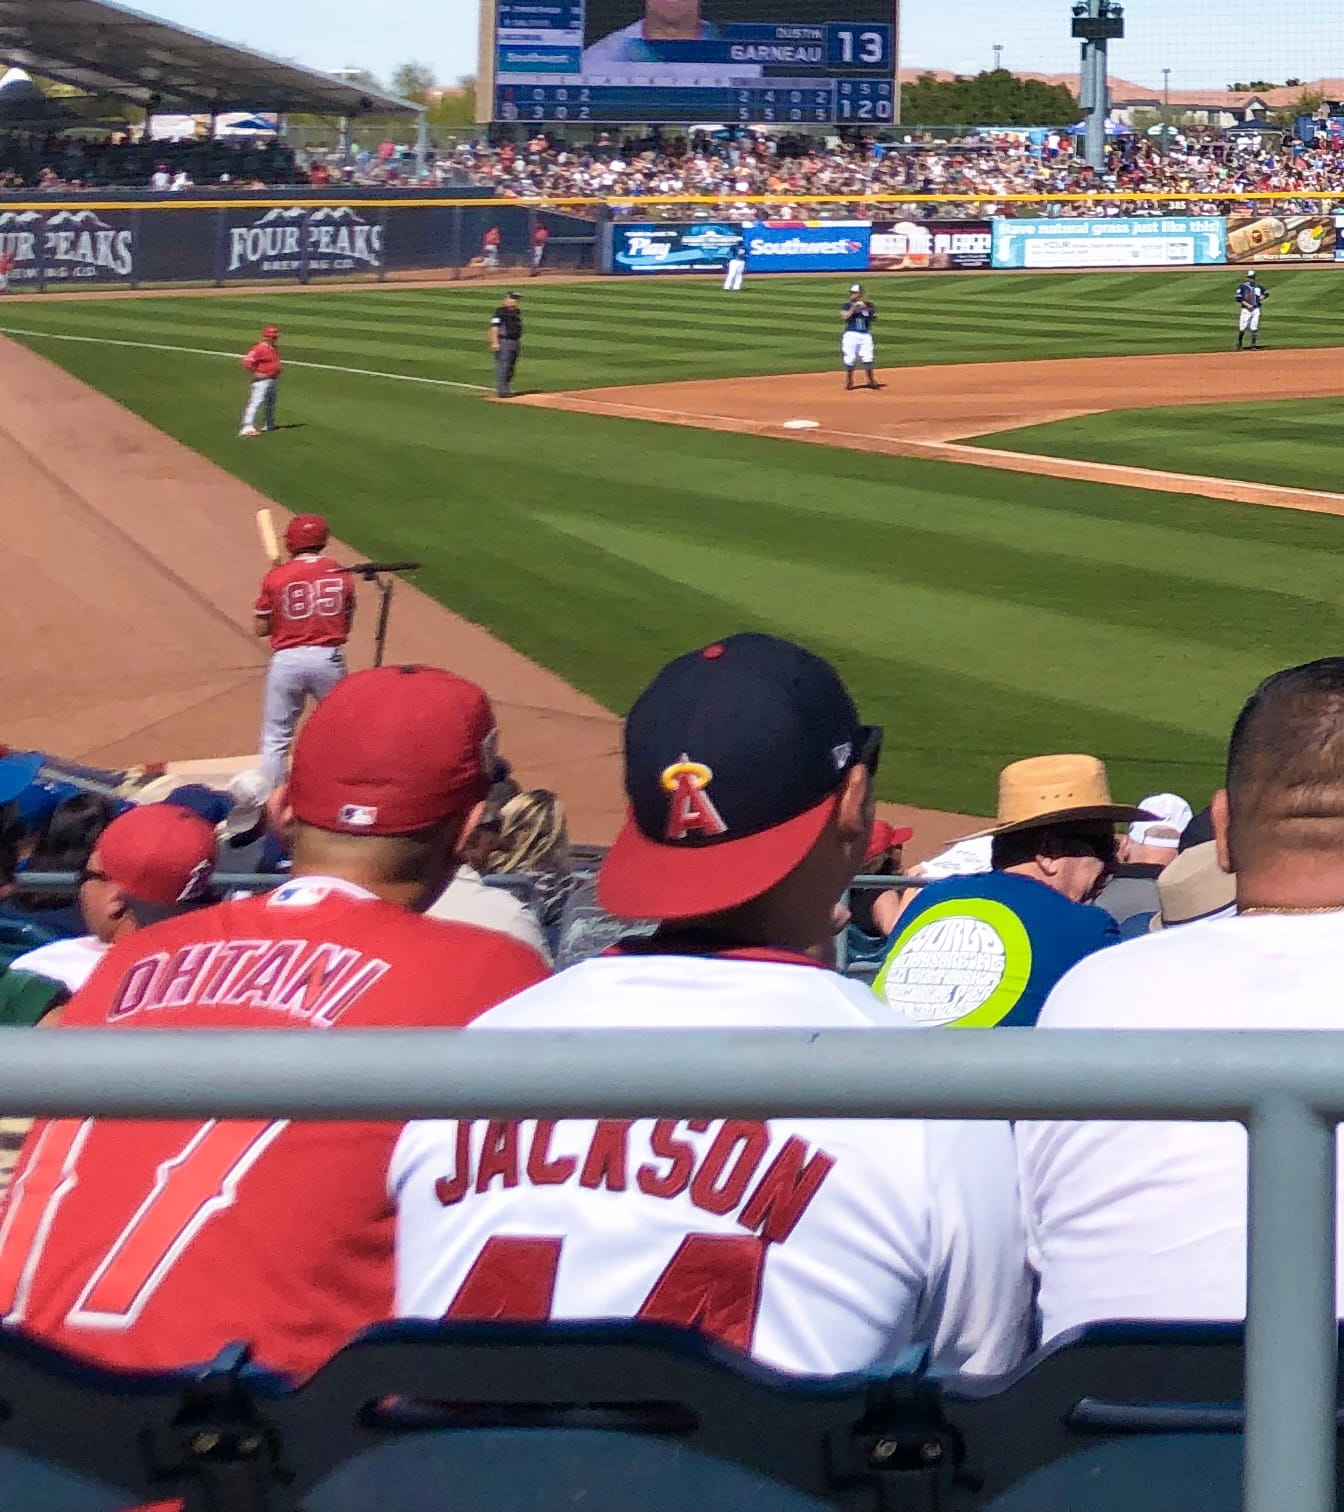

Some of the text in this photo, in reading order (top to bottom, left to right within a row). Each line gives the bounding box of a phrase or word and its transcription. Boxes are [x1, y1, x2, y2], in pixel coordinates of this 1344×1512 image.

[730, 45, 822, 62] GARNEAU
[838, 31, 883, 63] 13
[580, 89, 590, 101] 2
[739, 90, 750, 102] 2
[764, 91, 775, 102] 4
[816, 91, 827, 103] 2
[534, 106, 545, 119] 3
[580, 107, 590, 119] 2
[1038, 222, 1089, 234] natural
[1092, 223, 1130, 236] grass
[1132, 221, 1159, 235] just
[1161, 221, 1187, 233] like
[44, 230, 132, 275] PEAKS
[226, 225, 383, 272] FOUR PEAKS
[750, 238, 849, 255] Southwest
[283, 578, 344, 620] 85
[106, 939, 392, 1029] OHTANI
[436, 1118, 837, 1245] JACKSON
